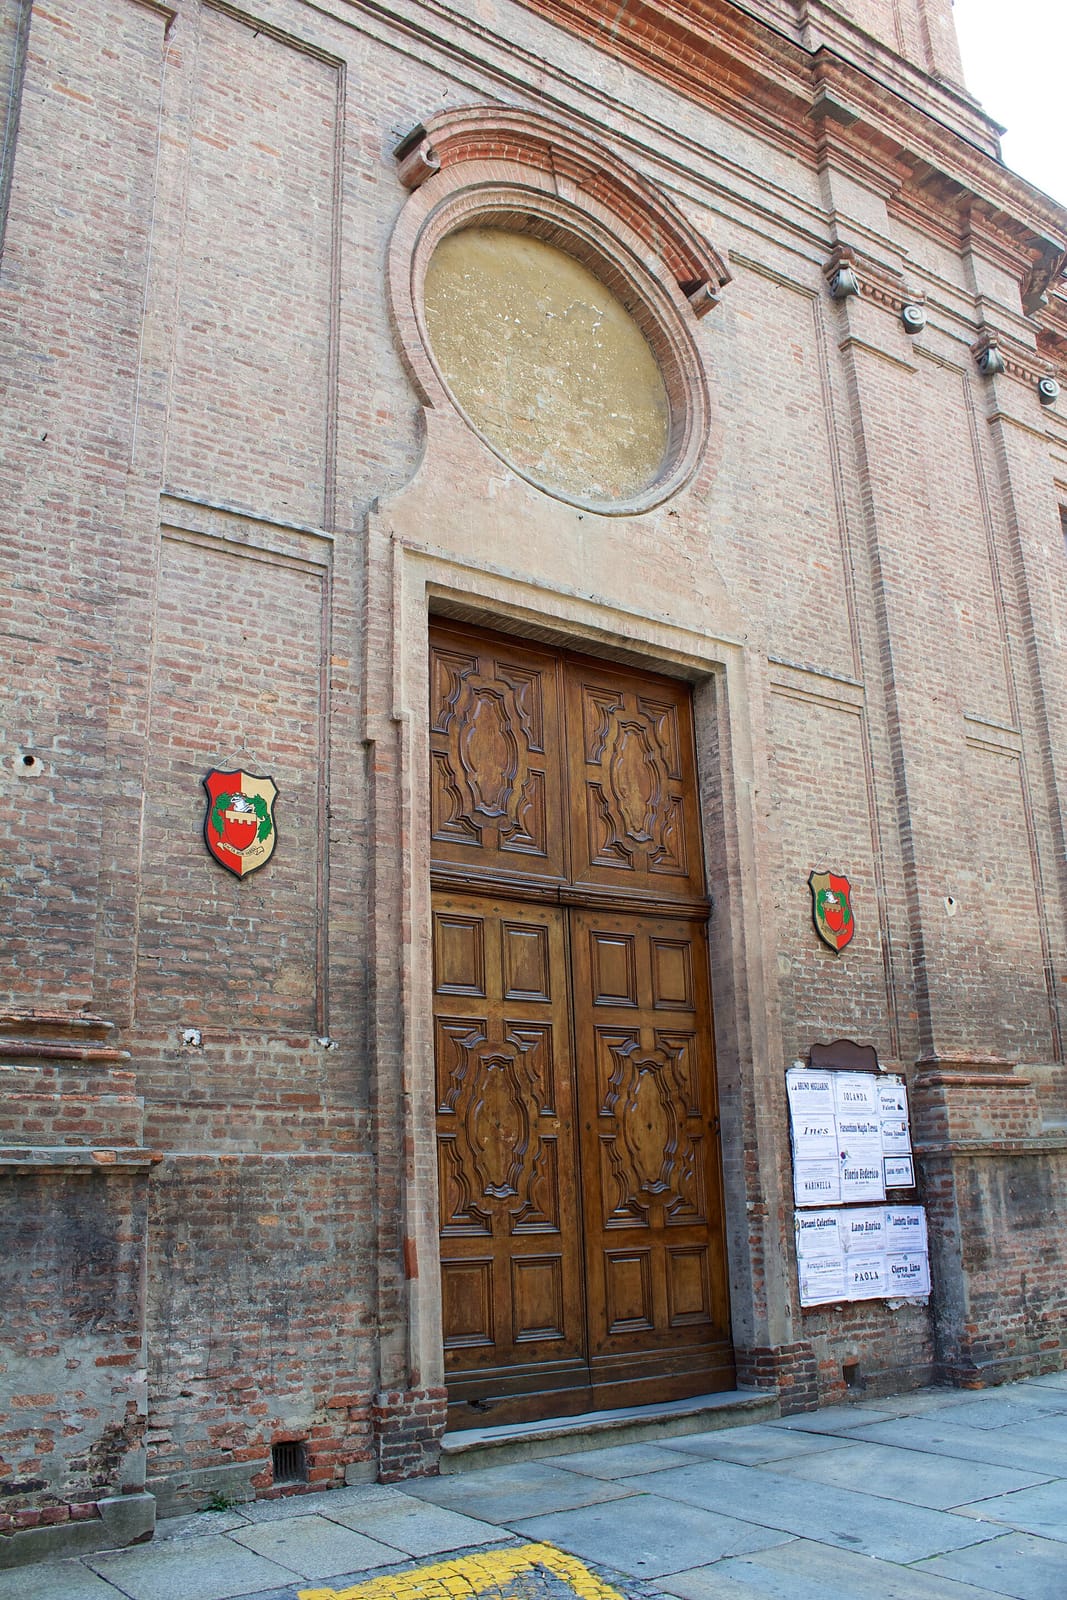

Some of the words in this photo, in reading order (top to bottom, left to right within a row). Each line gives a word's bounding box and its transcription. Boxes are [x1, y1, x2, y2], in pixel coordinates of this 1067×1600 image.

[843, 1092, 868, 1101] IOLANDA
[803, 1126, 829, 1135] Ines
[859, 1167, 879, 1180] Federico
[805, 1181, 831, 1190] MARINELLA
[864, 1221, 881, 1231] Enrico
[909, 1263, 921, 1273] Lina
[854, 1271, 879, 1282] PAOLA
